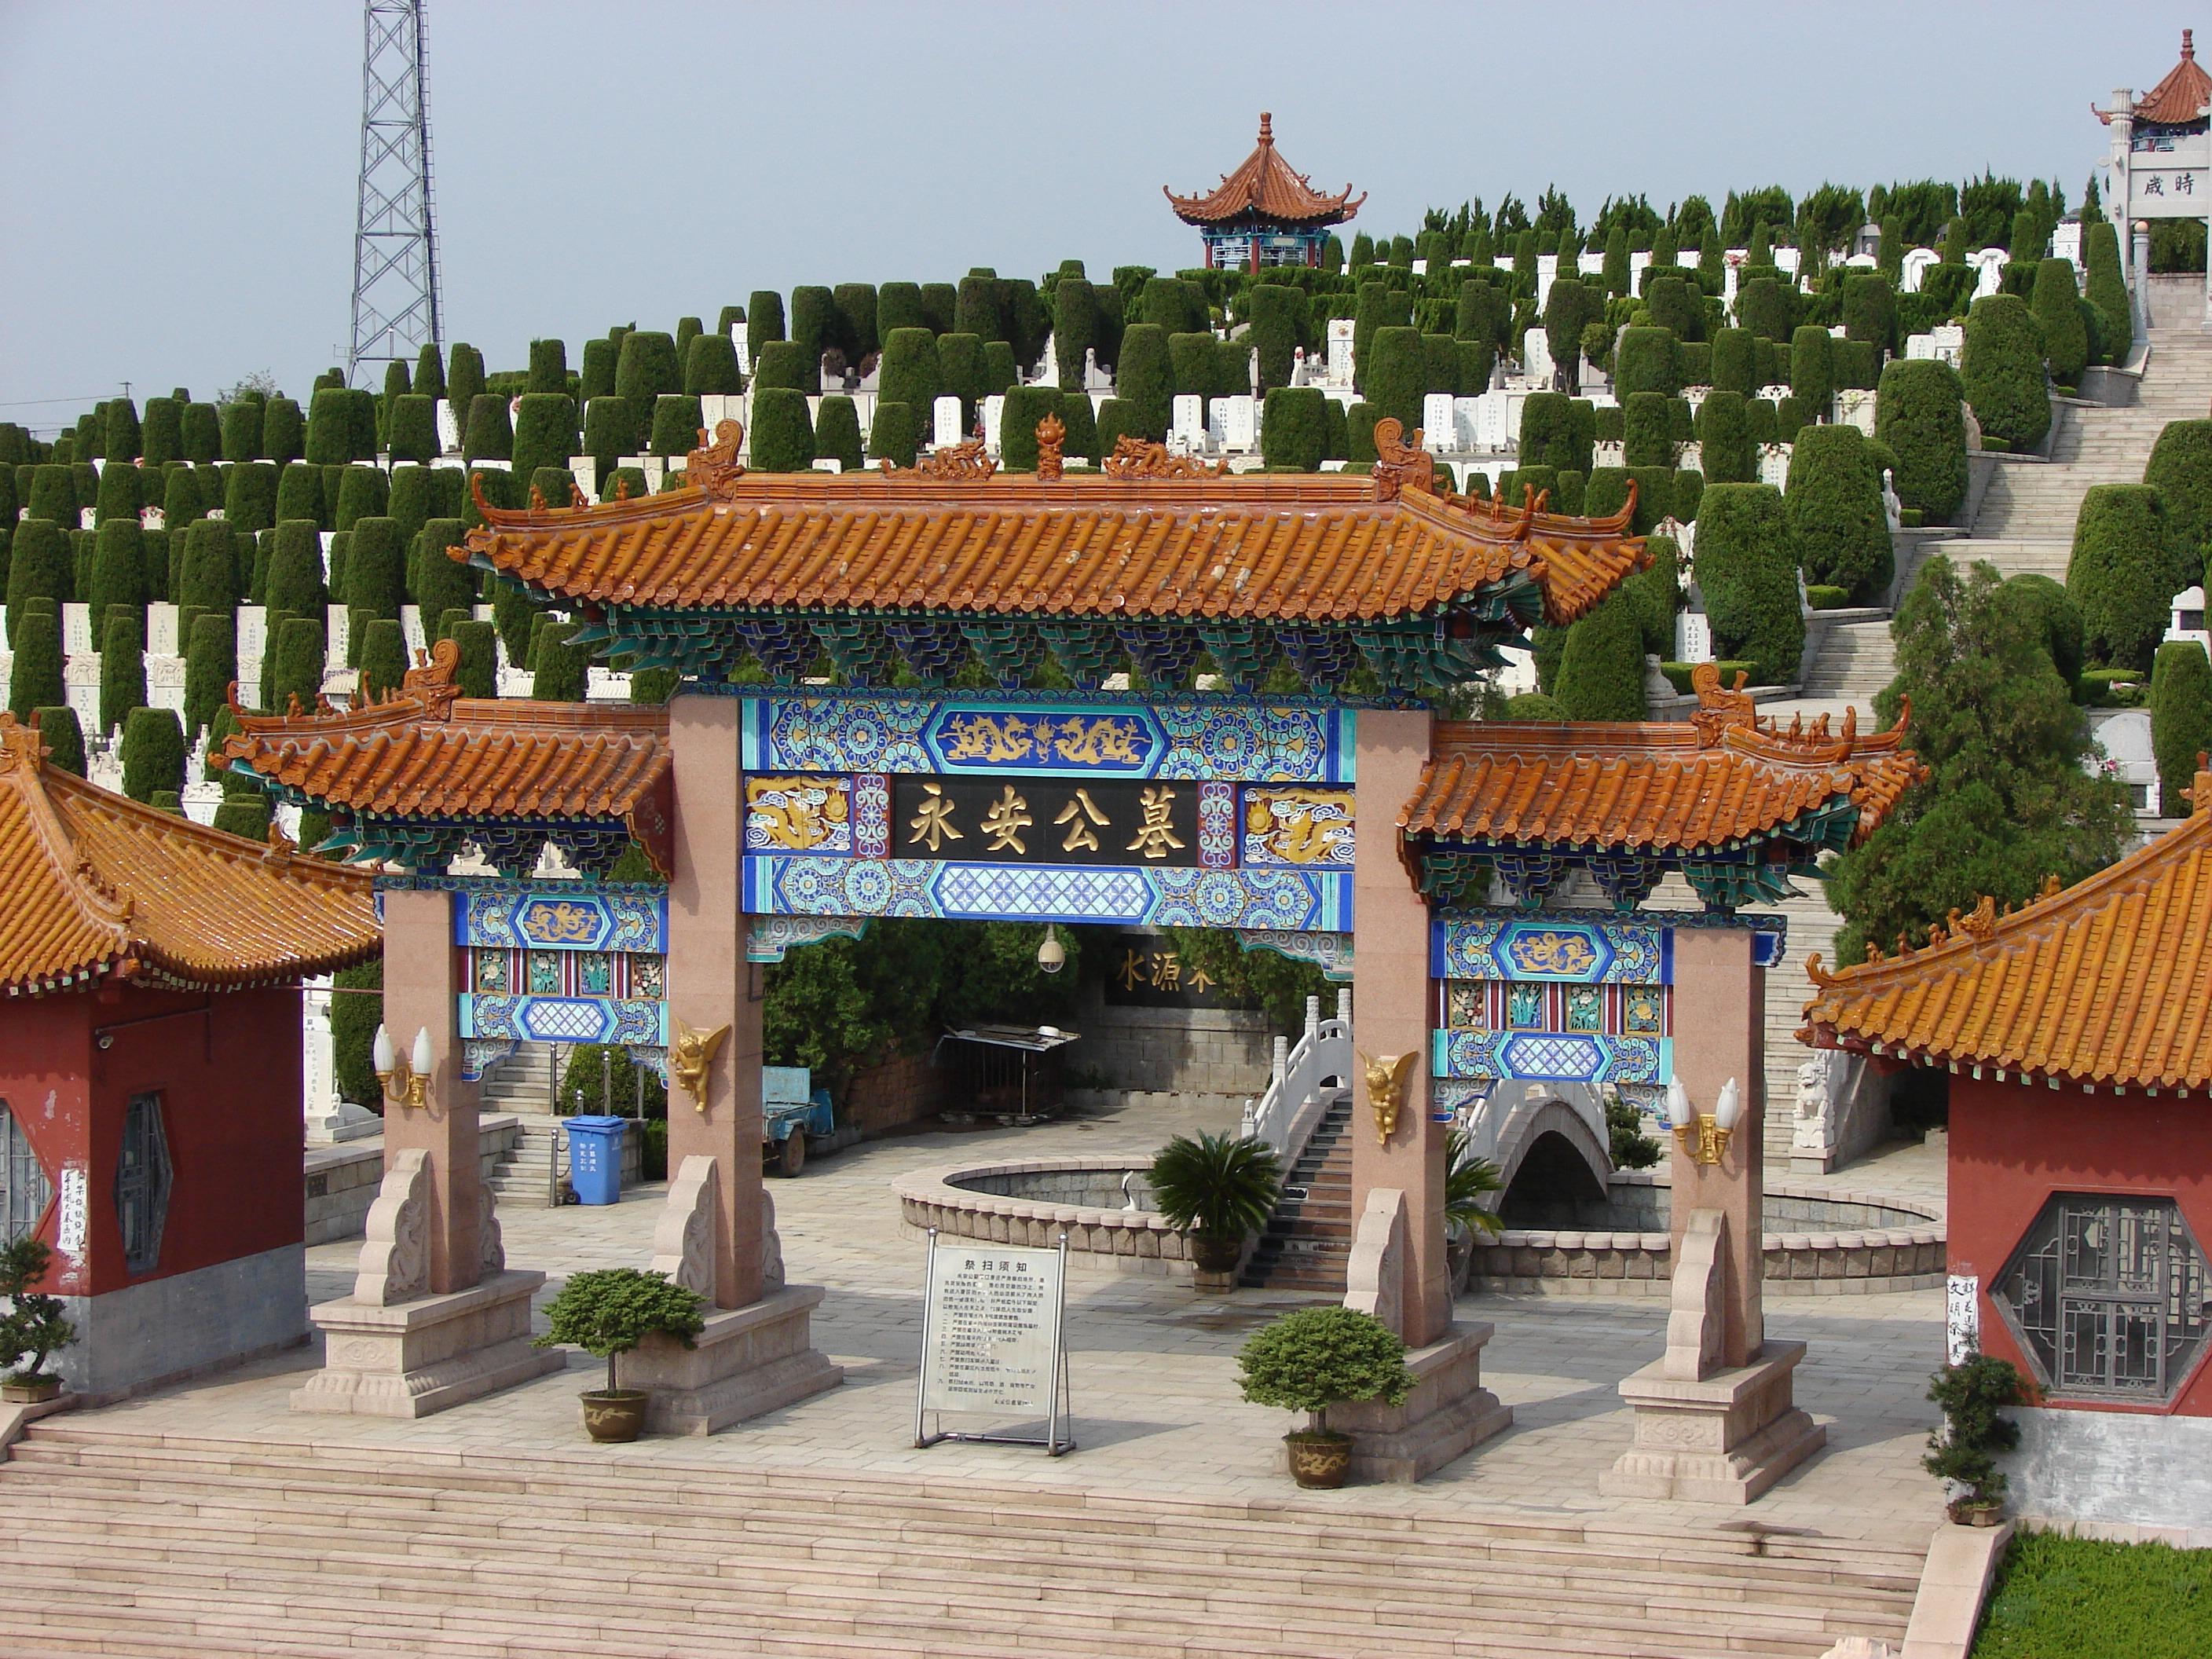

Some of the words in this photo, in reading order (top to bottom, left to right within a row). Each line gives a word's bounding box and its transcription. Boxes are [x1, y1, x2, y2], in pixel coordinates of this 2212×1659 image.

[908, 782, 1186, 859] 永安公墓
[965, 1259, 1027, 1273] 祭扫须知
